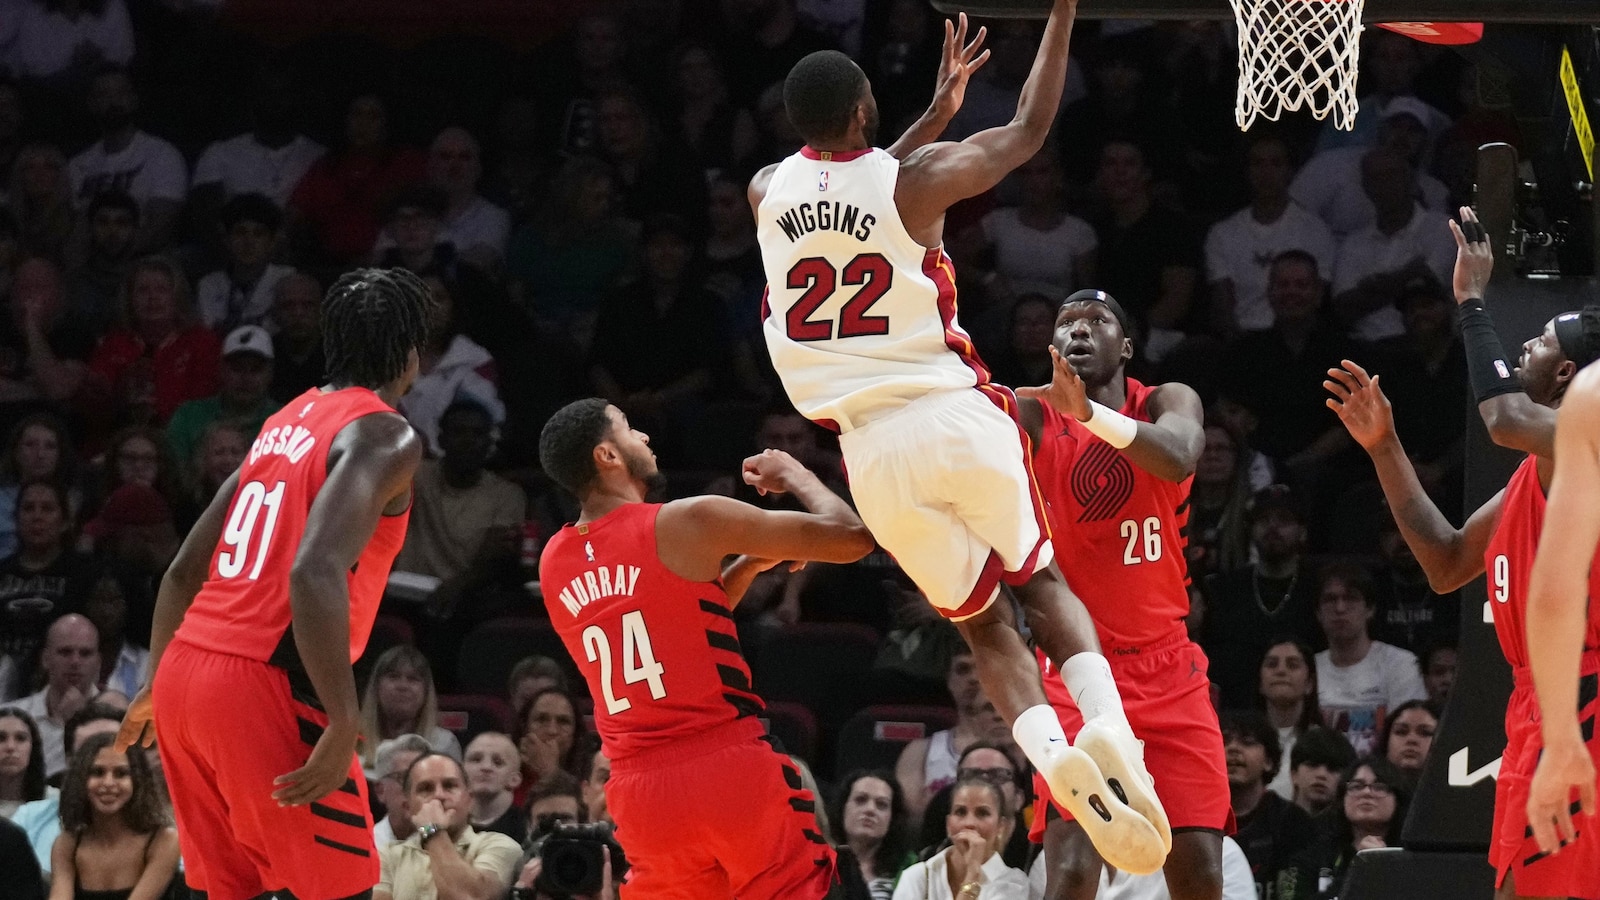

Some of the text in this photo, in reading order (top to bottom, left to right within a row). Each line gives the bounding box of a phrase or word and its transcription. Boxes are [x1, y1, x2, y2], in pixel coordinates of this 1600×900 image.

[776, 201, 876, 243] WIGGINS
[786, 253, 893, 341] 22
[218, 480, 286, 580] 91
[1119, 516, 1162, 566] 26
[558, 564, 642, 618] MURRAY
[1494, 554, 1510, 603] 9
[582, 609, 667, 716] 24
